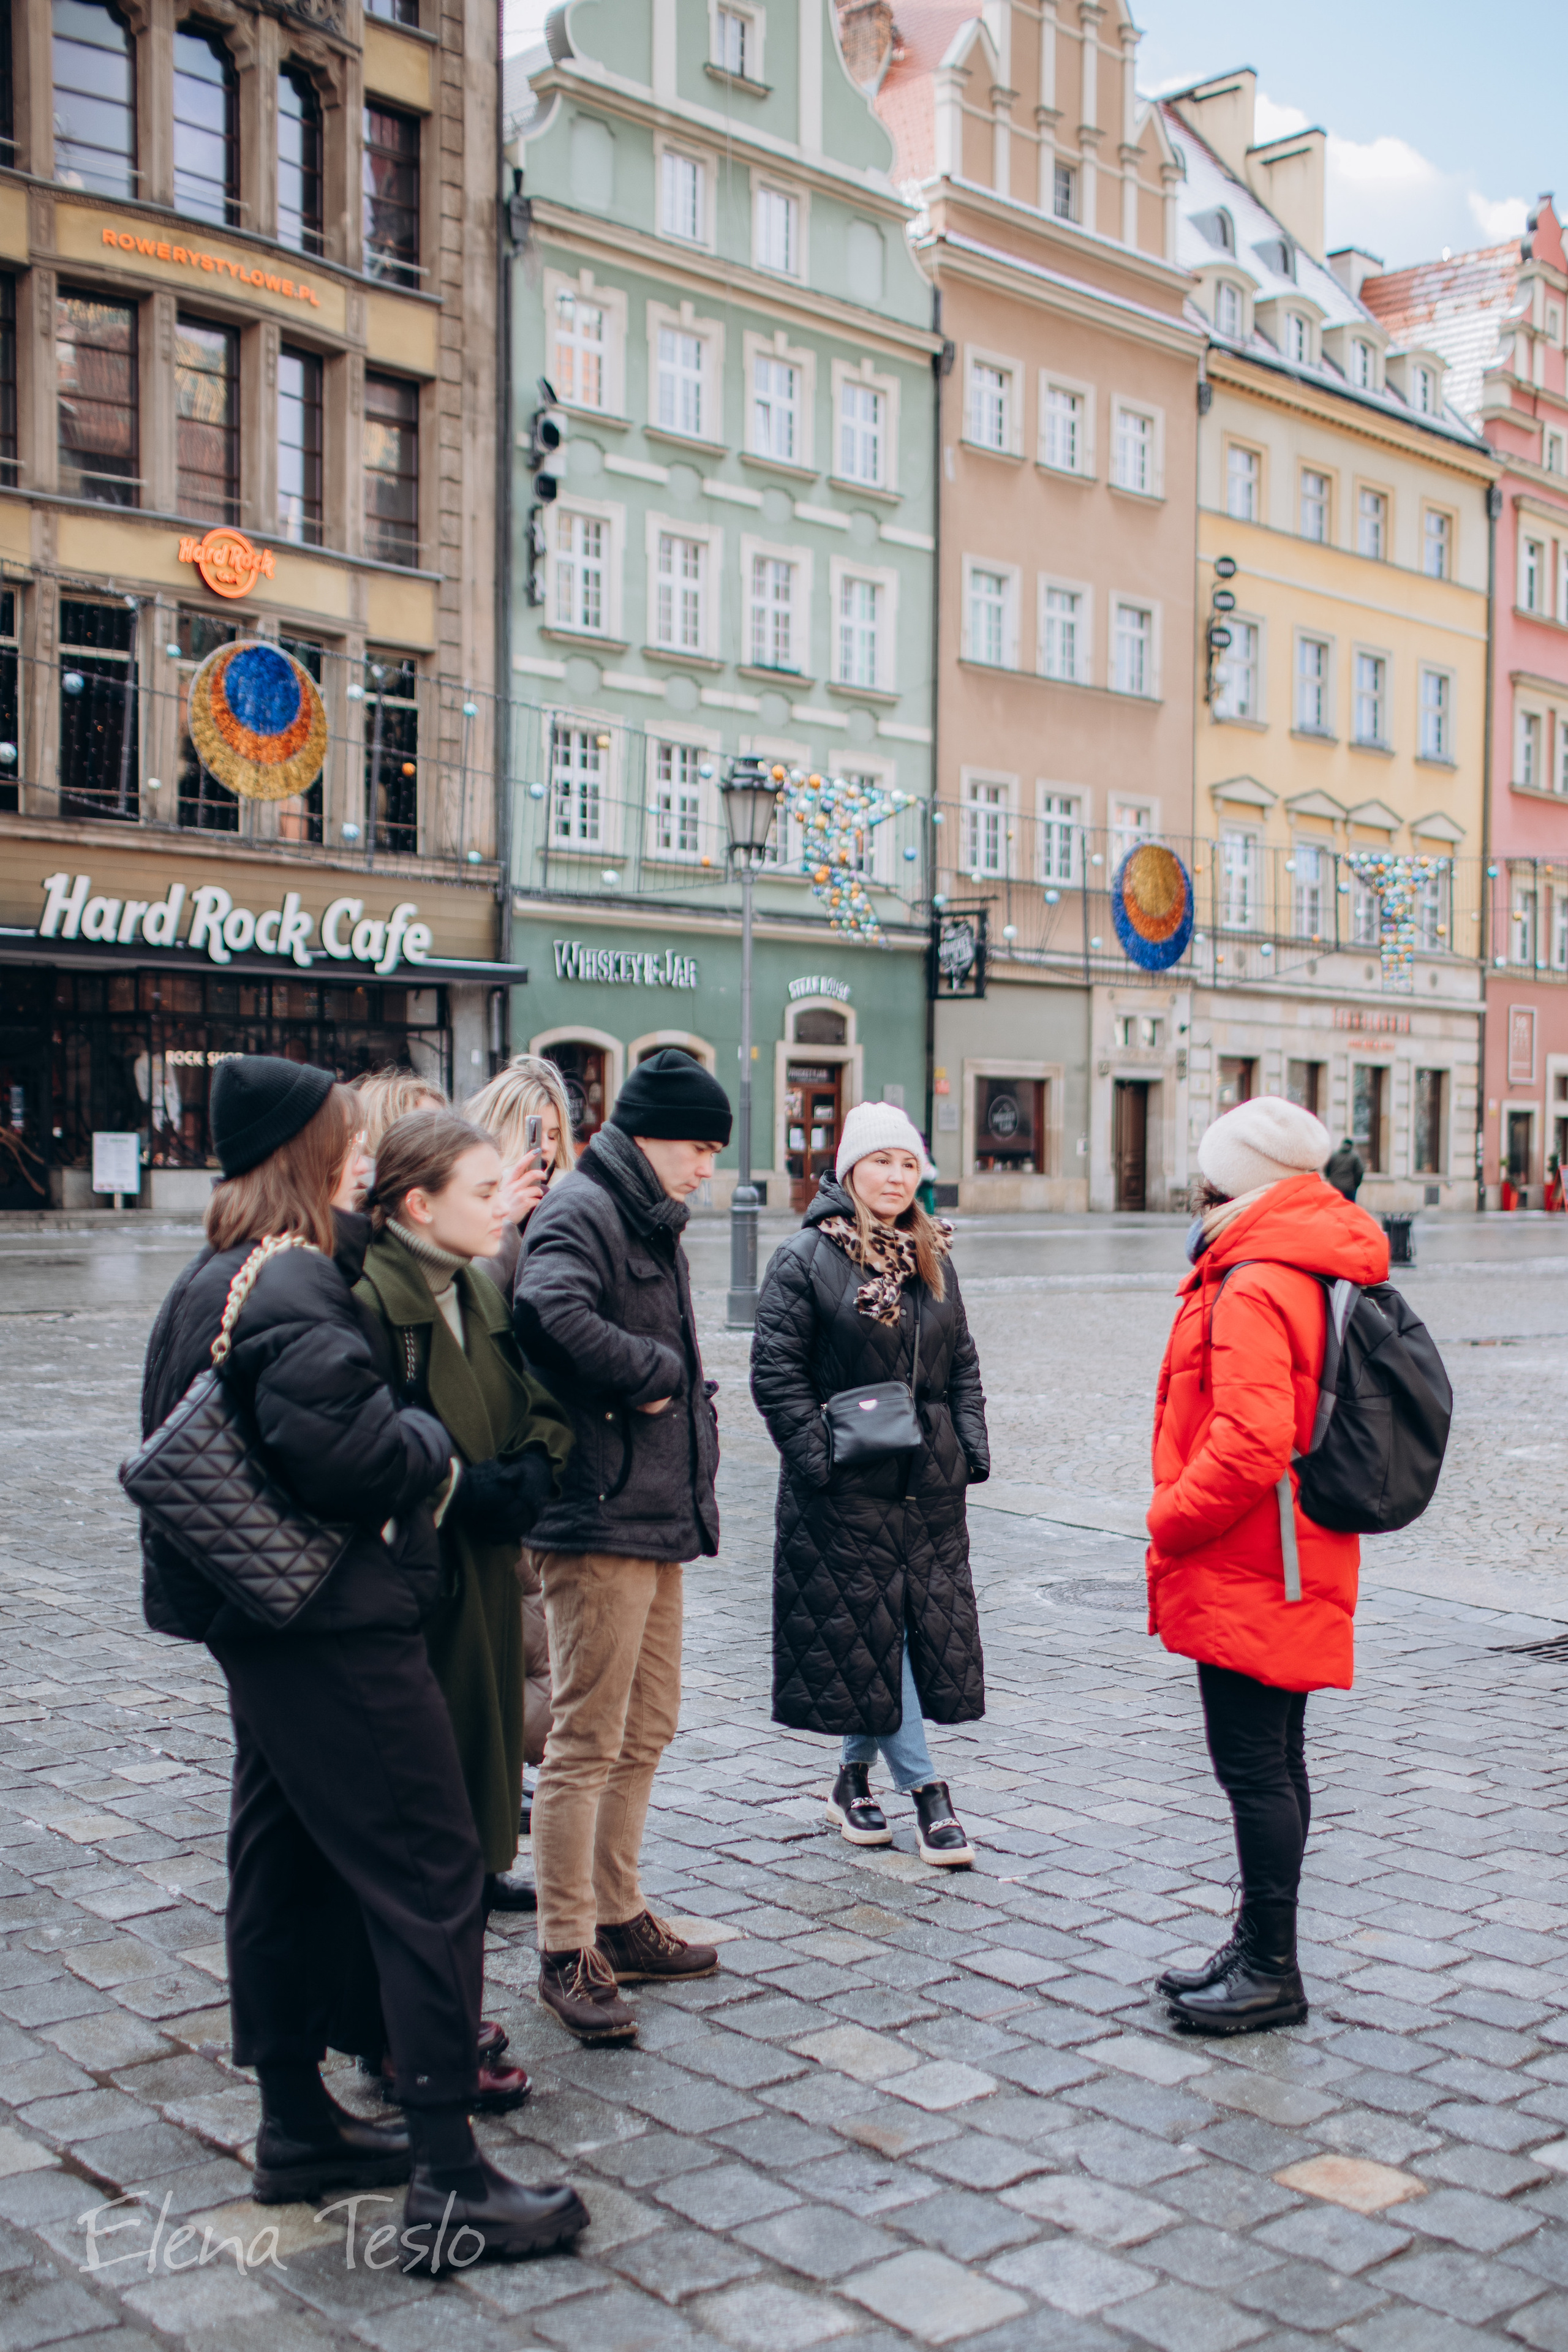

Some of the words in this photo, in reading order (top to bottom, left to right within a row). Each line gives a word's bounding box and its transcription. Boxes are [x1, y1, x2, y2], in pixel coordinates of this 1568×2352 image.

[102, 228, 320, 307] ROWERYSTYLOWE.PL
[179, 537, 231, 567] Hard
[228, 544, 276, 579] Rock
[39, 872, 186, 947] Hard
[189, 885, 313, 967] Rock
[322, 897, 432, 975] Cafe
[165, 1050, 205, 1067] ROCK
